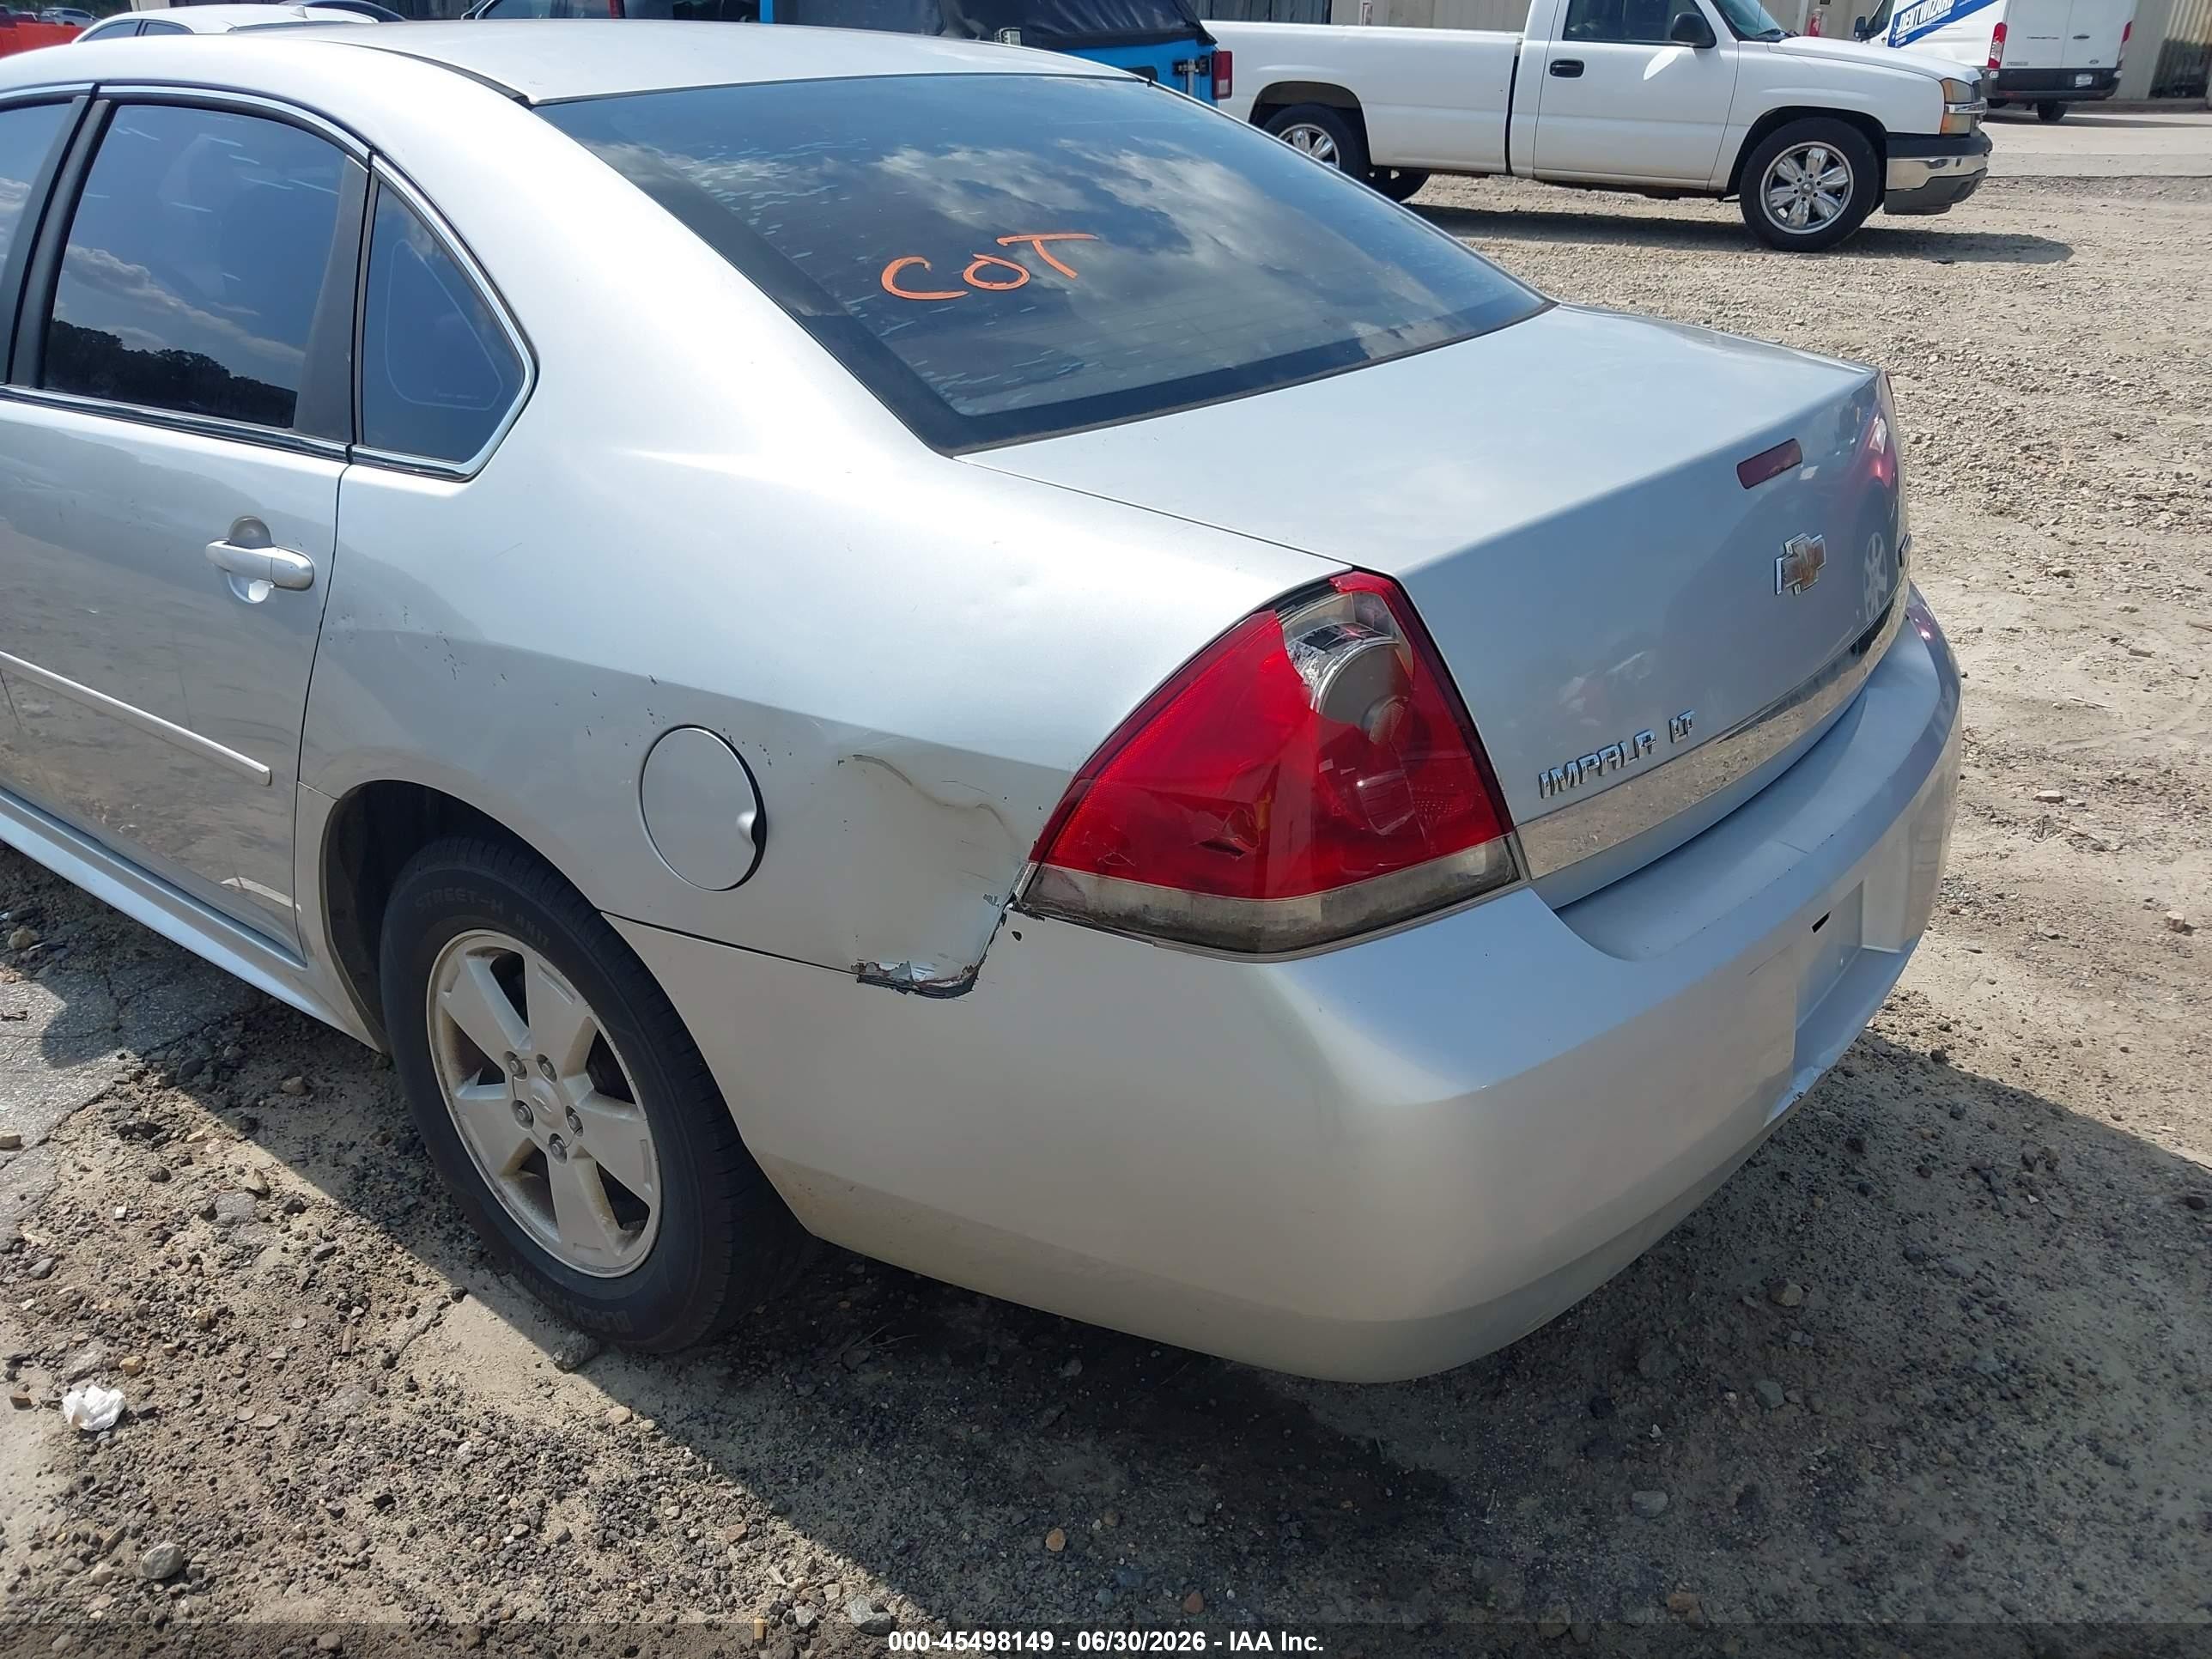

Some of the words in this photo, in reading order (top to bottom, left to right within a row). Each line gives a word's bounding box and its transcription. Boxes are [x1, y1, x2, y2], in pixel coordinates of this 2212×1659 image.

[881, 233, 1099, 300] COT
[1539, 729, 1656, 799] IMPALA
[1669, 710, 1696, 744] LT
